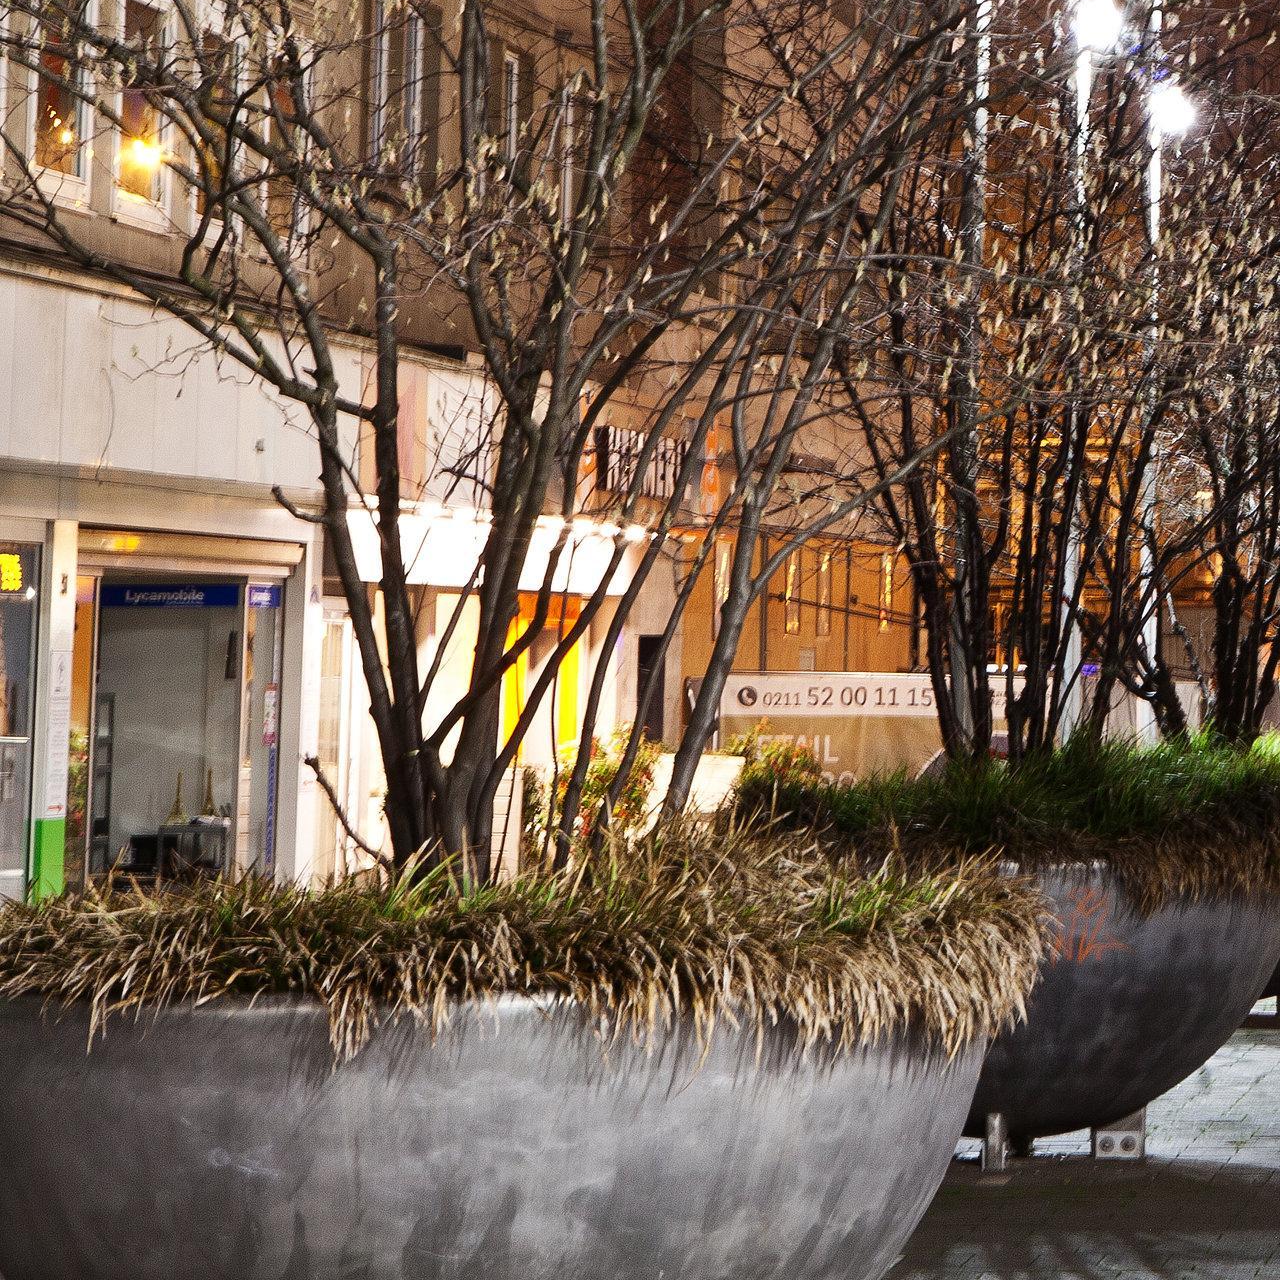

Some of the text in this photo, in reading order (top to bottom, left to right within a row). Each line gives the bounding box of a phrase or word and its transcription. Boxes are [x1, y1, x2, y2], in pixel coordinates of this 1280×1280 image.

[125, 588, 205, 603] Lycamobile
[762, 686, 934, 708] 0211 52 00 11 15
